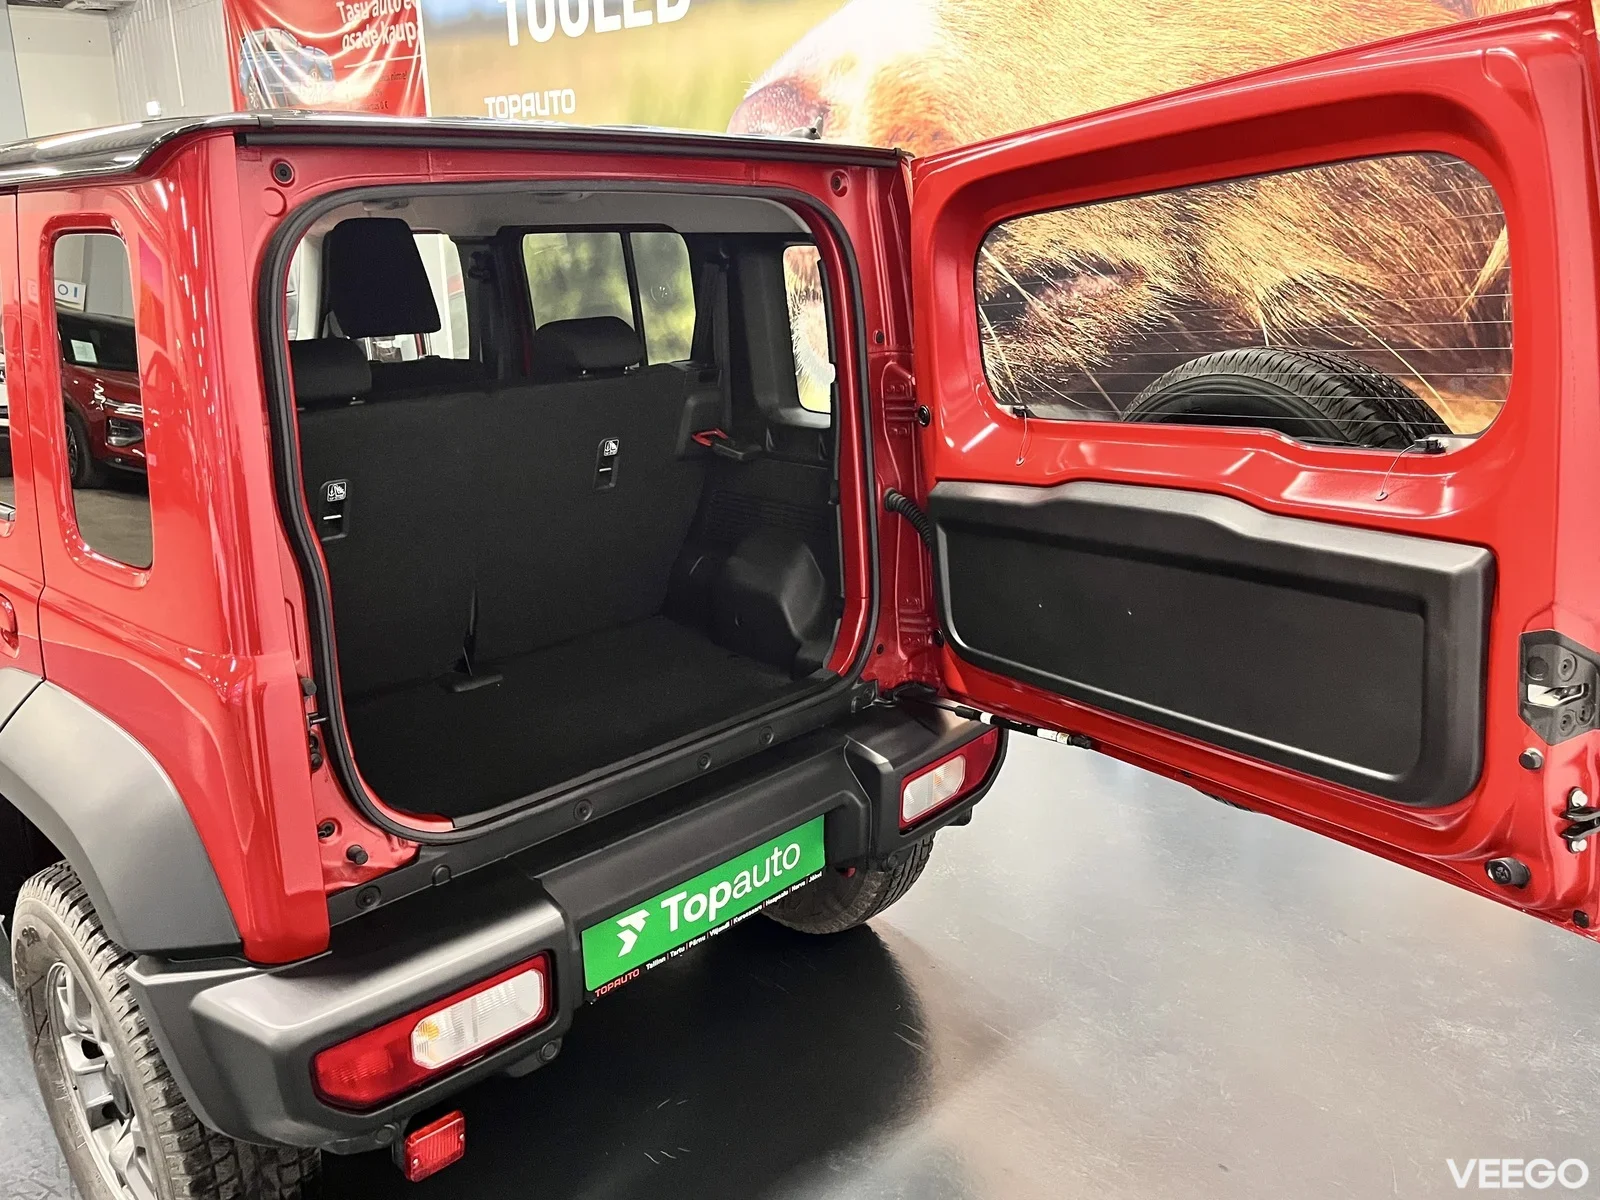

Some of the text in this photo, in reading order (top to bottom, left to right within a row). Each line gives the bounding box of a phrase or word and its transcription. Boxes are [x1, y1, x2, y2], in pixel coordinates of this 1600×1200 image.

[336, 1, 370, 23] Tasu
[372, 0, 402, 17] auto
[342, 21, 419, 51] osade kaup
[484, 88, 576, 119] TOPAUTO
[660, 842, 801, 932] Topauto
[594, 968, 640, 997] TOPAUTO
[645, 955, 666, 971] Tallinn
[670, 946, 686, 958] Tartu
